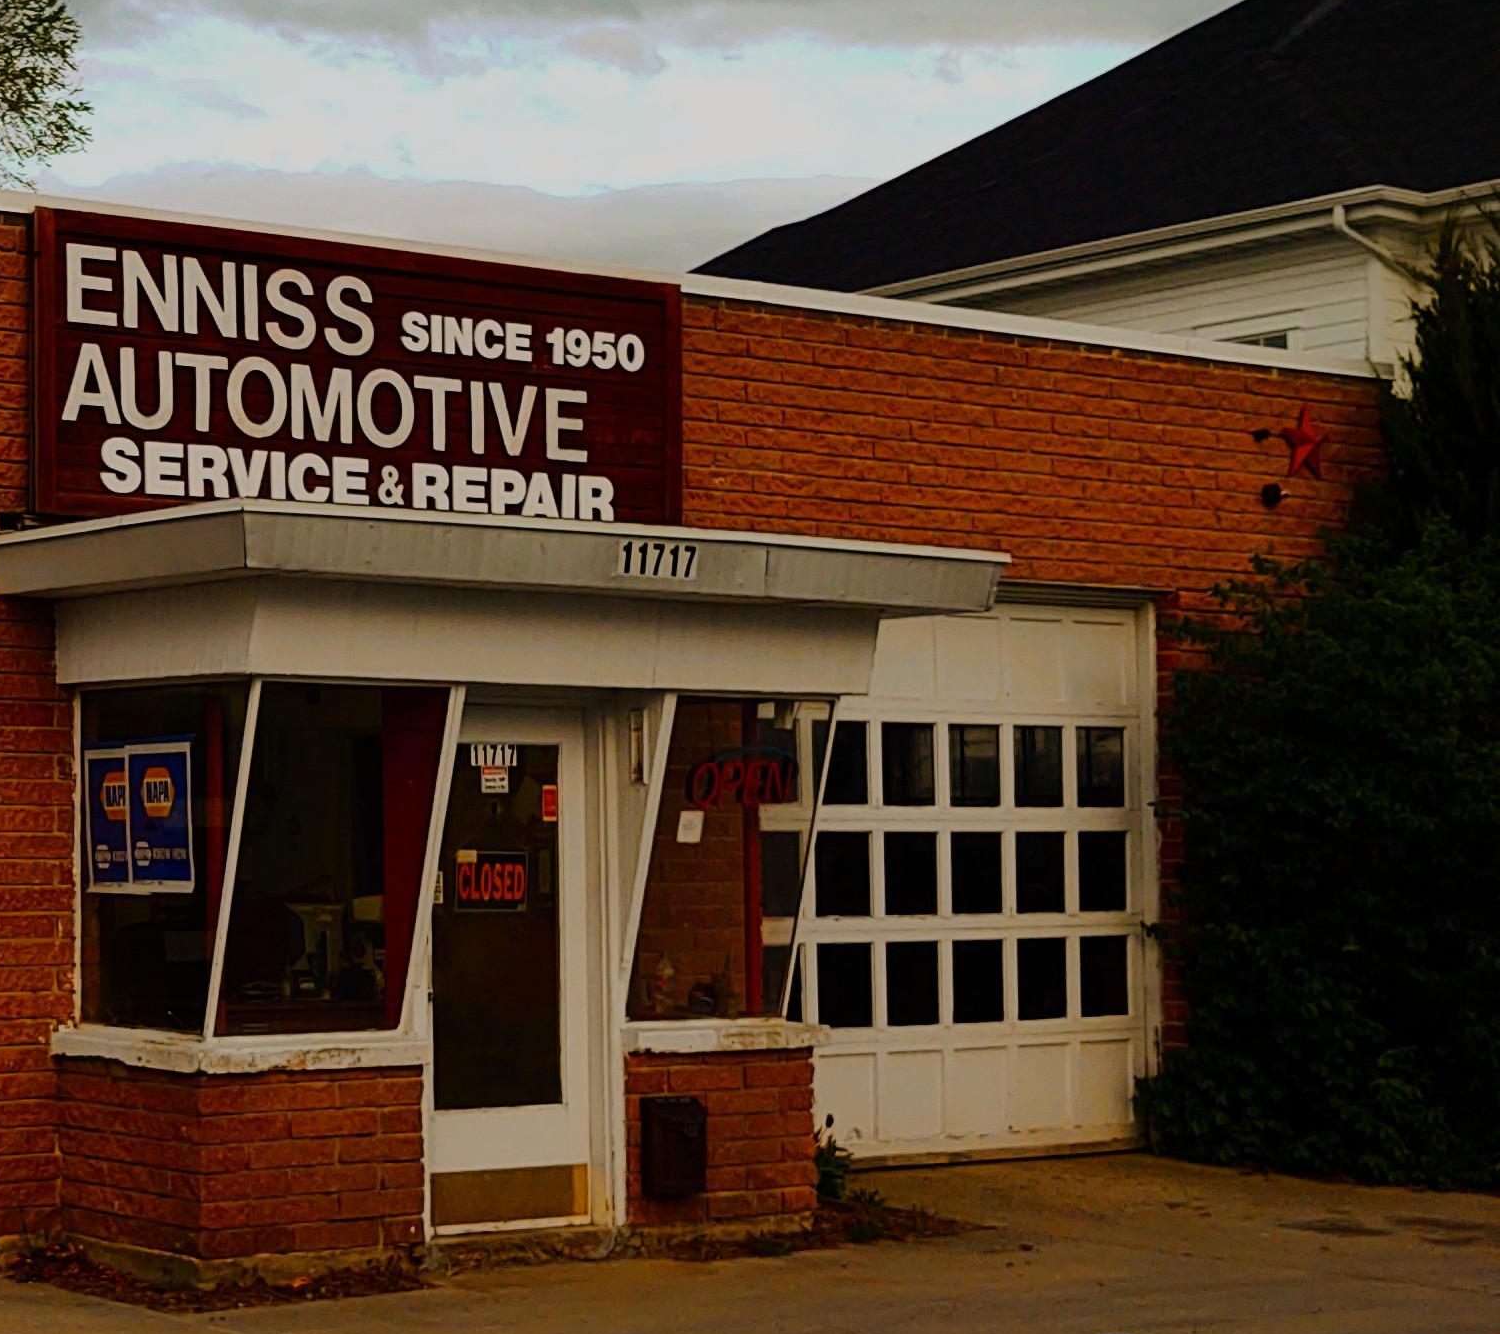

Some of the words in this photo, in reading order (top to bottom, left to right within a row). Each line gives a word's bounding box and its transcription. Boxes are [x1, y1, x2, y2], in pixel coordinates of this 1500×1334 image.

[65, 242, 375, 357] ENNISS
[400, 310, 534, 363] SINCE
[545, 326, 646, 373] 1950
[61, 342, 589, 464] AUTOMOTIVE
[100, 436, 370, 506] SERVICE
[377, 464, 405, 506] &
[411, 462, 615, 522] REPAIR
[623, 541, 697, 578] 11717
[473, 744, 515, 765] 11717
[145, 780, 170, 804] NAPA
[692, 761, 793, 806] OPEN
[458, 861, 526, 902] CLOSED
